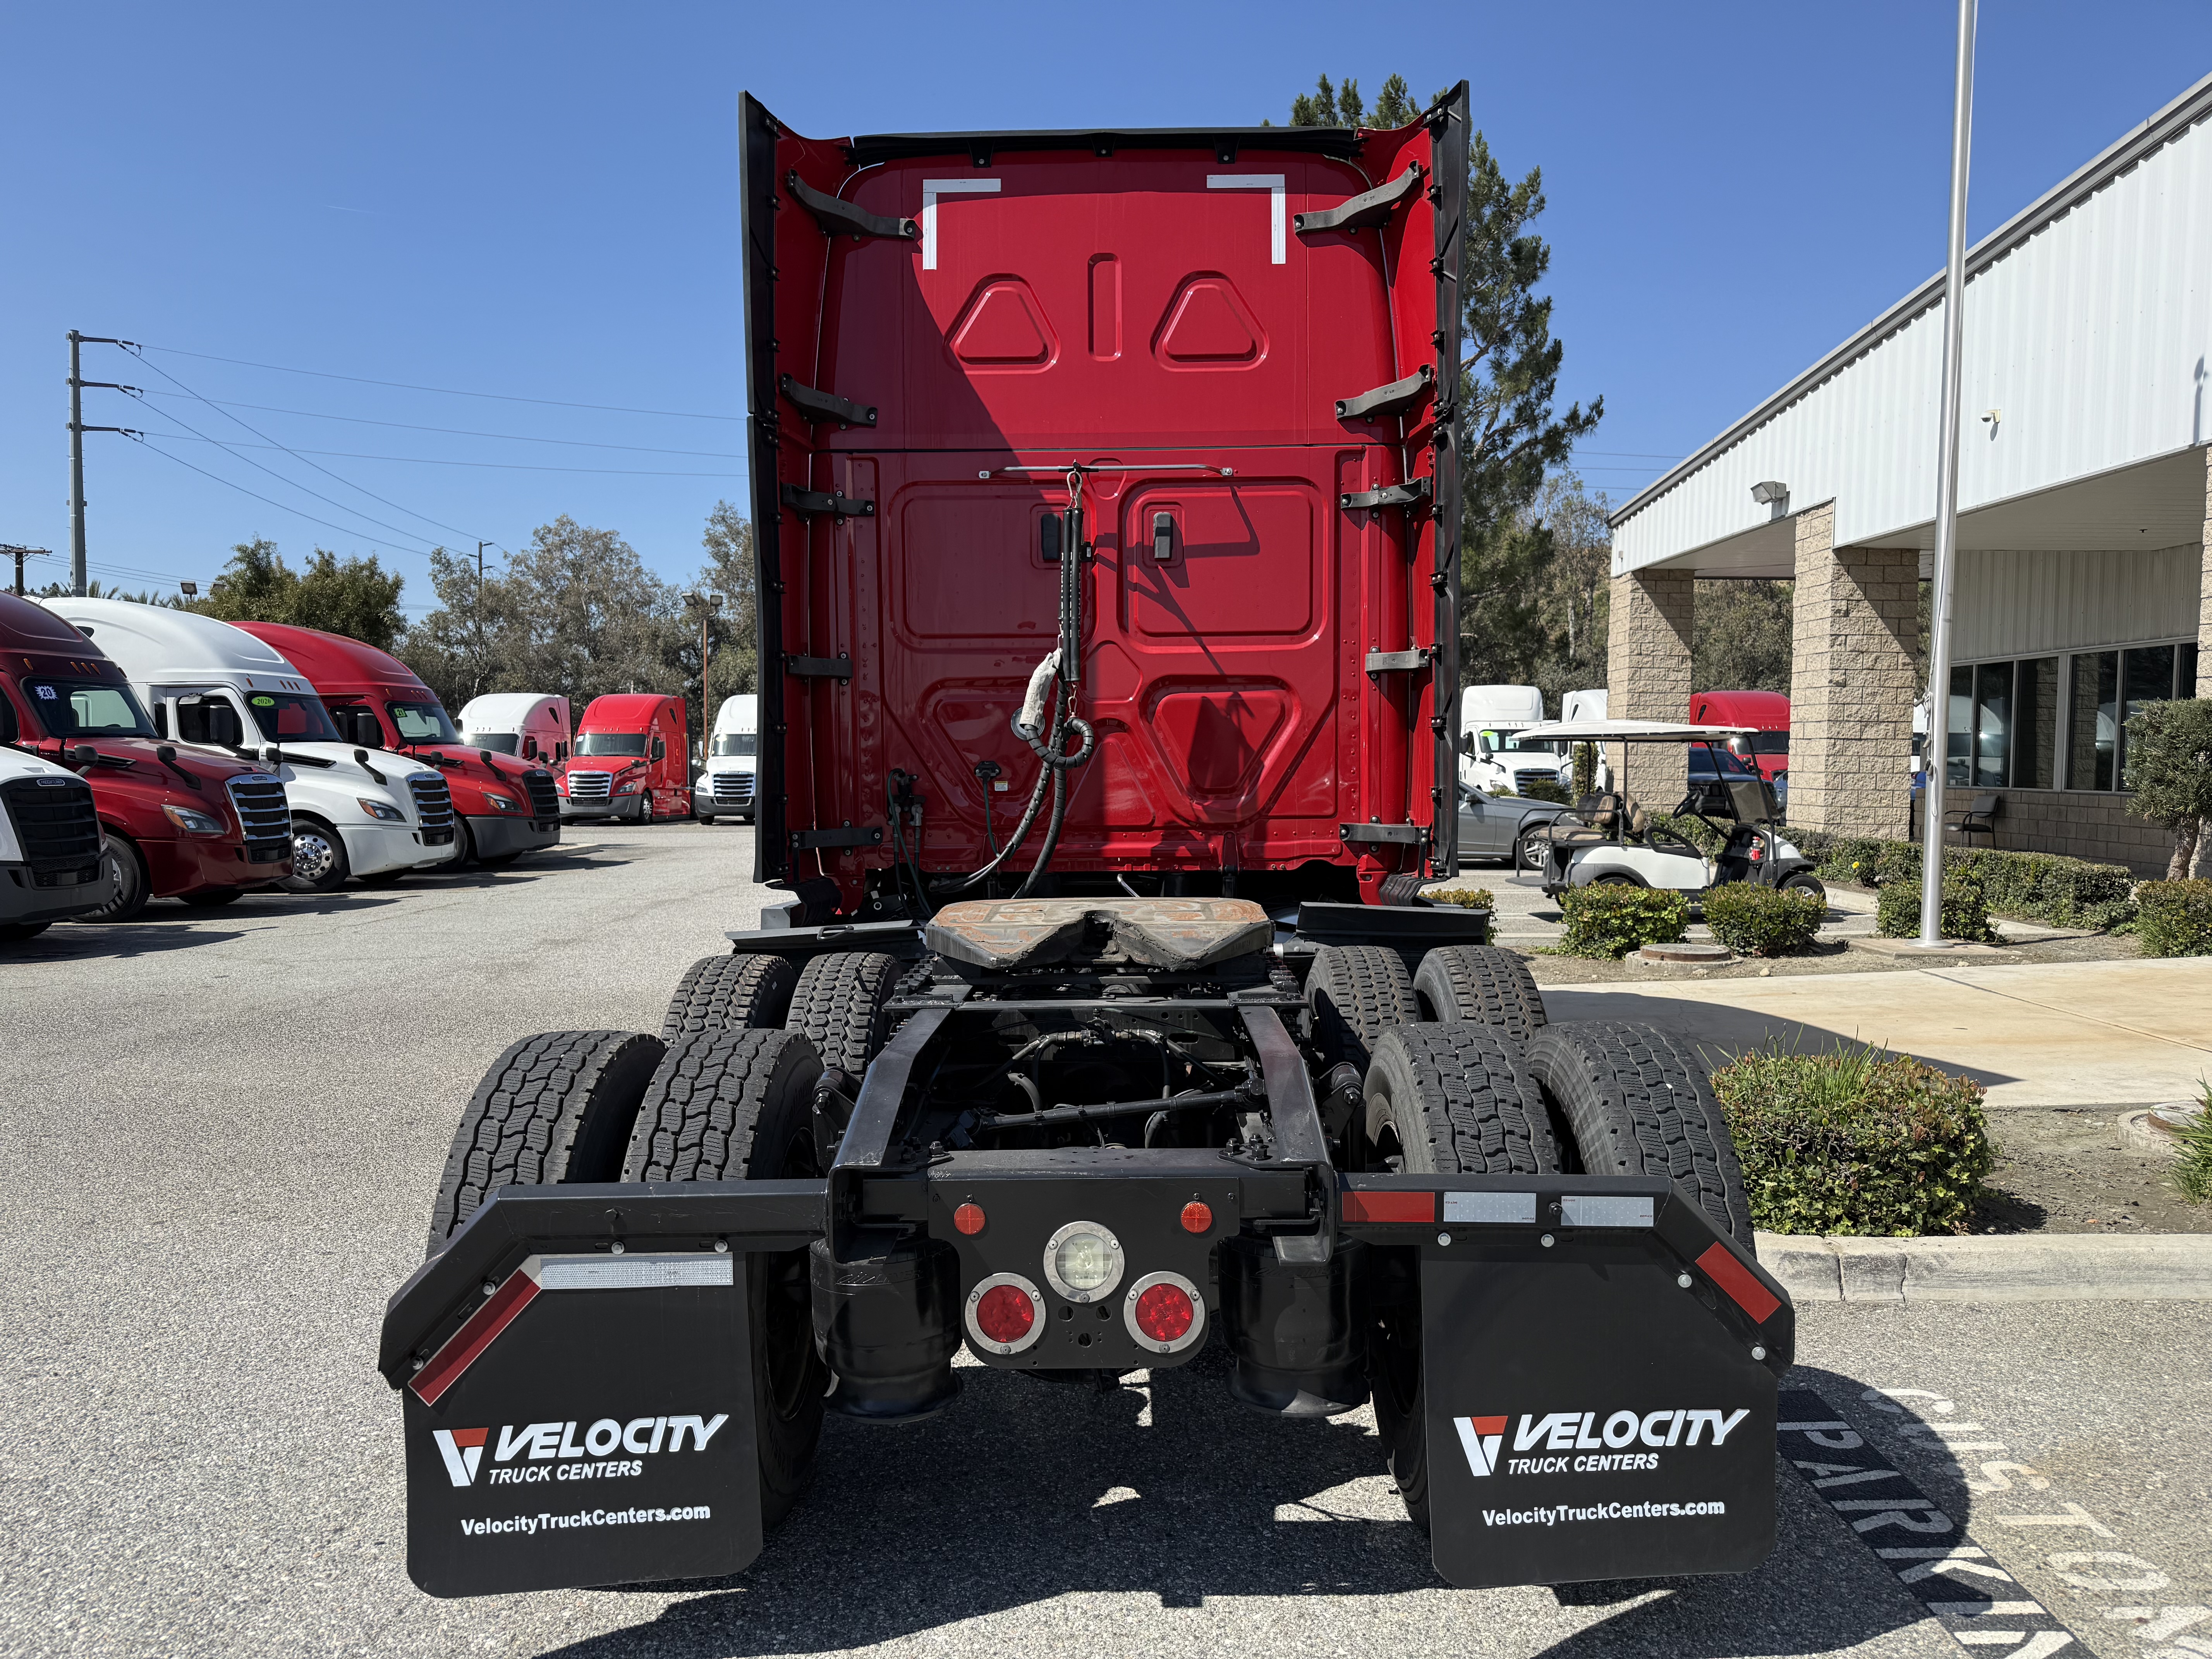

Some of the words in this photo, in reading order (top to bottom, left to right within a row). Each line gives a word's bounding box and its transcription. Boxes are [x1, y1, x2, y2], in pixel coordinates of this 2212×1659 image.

[41, 688, 52, 697] 20
[494, 1413, 730, 1462] VELOCITY
[1513, 1408, 1750, 1451] VELOCITY
[489, 1465, 553, 1484] TRUCK
[556, 1460, 642, 1480] CENTERS
[1508, 1456, 1570, 1475] TRUCK
[1574, 1453, 1659, 1472] CENTERS
[460, 1506, 711, 1535] VelocityTruckCenters.com
[1482, 1501, 1725, 1527] VelocityTruckCenters.com
